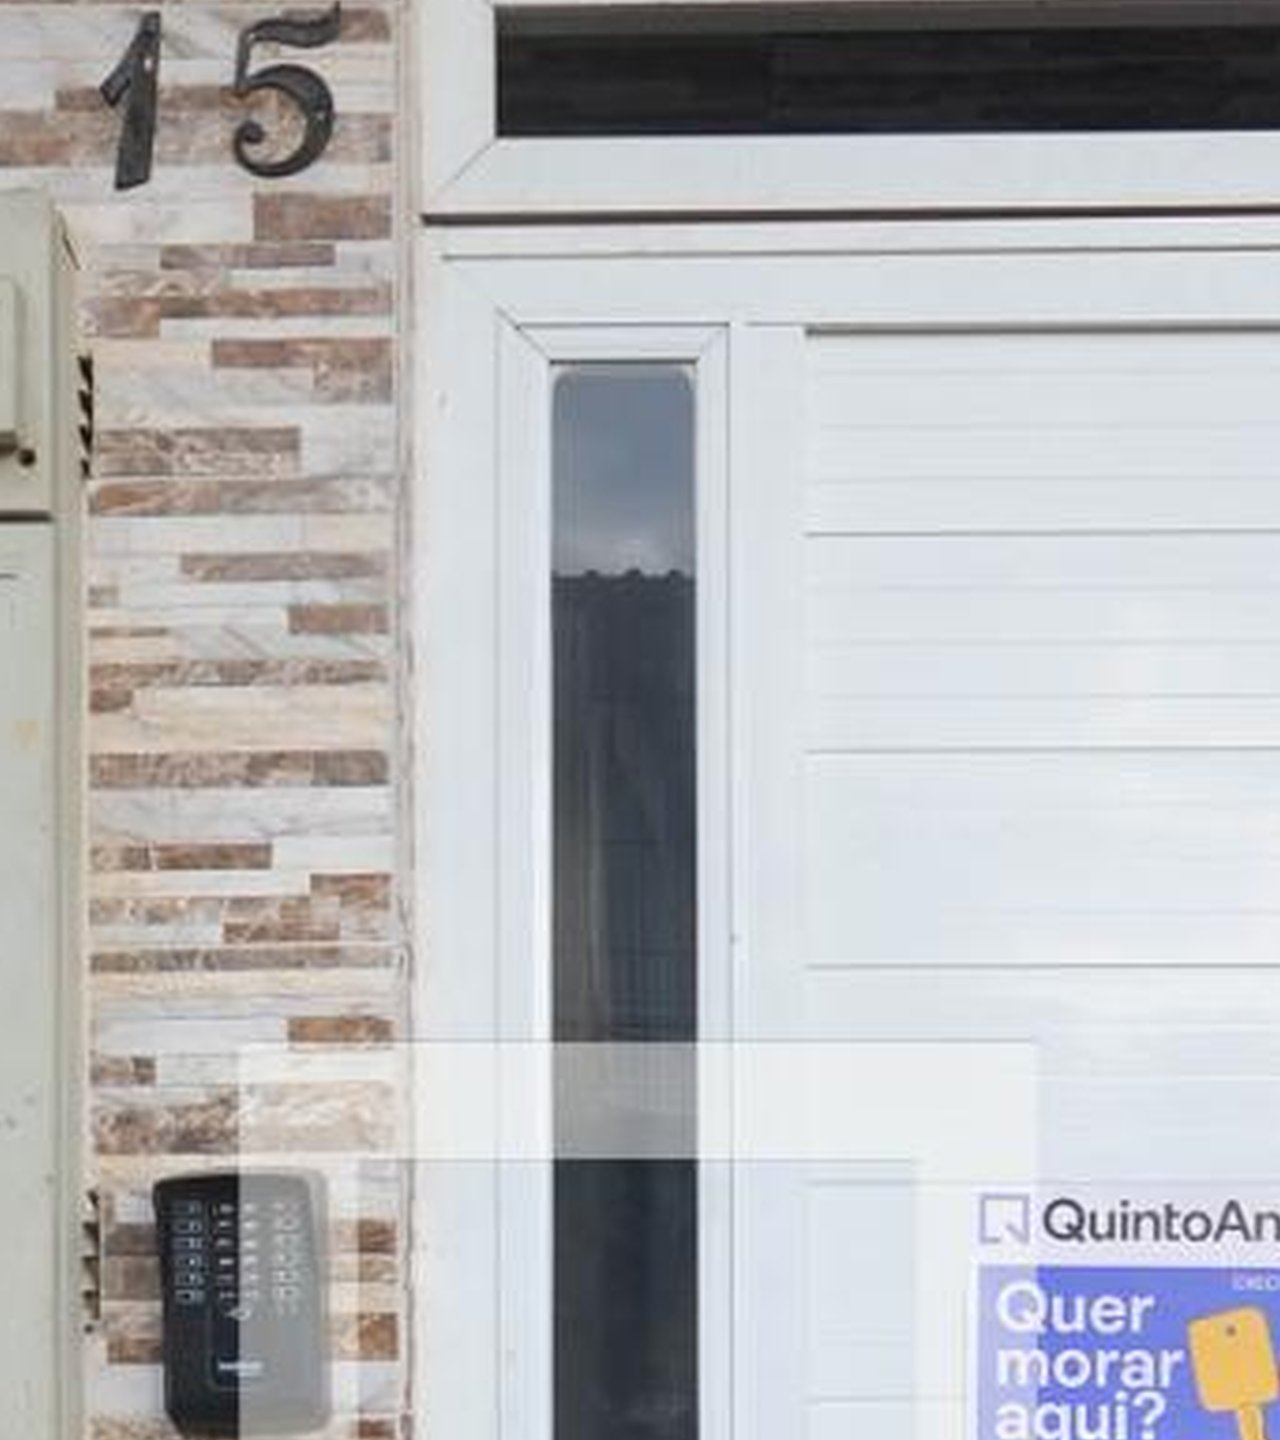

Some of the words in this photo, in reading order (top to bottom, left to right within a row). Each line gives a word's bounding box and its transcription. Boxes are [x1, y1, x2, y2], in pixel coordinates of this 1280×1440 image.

[99, 1, 341, 191] 15
[997, 1281, 1155, 1334] Quer
[997, 1348, 1184, 1388] morar
